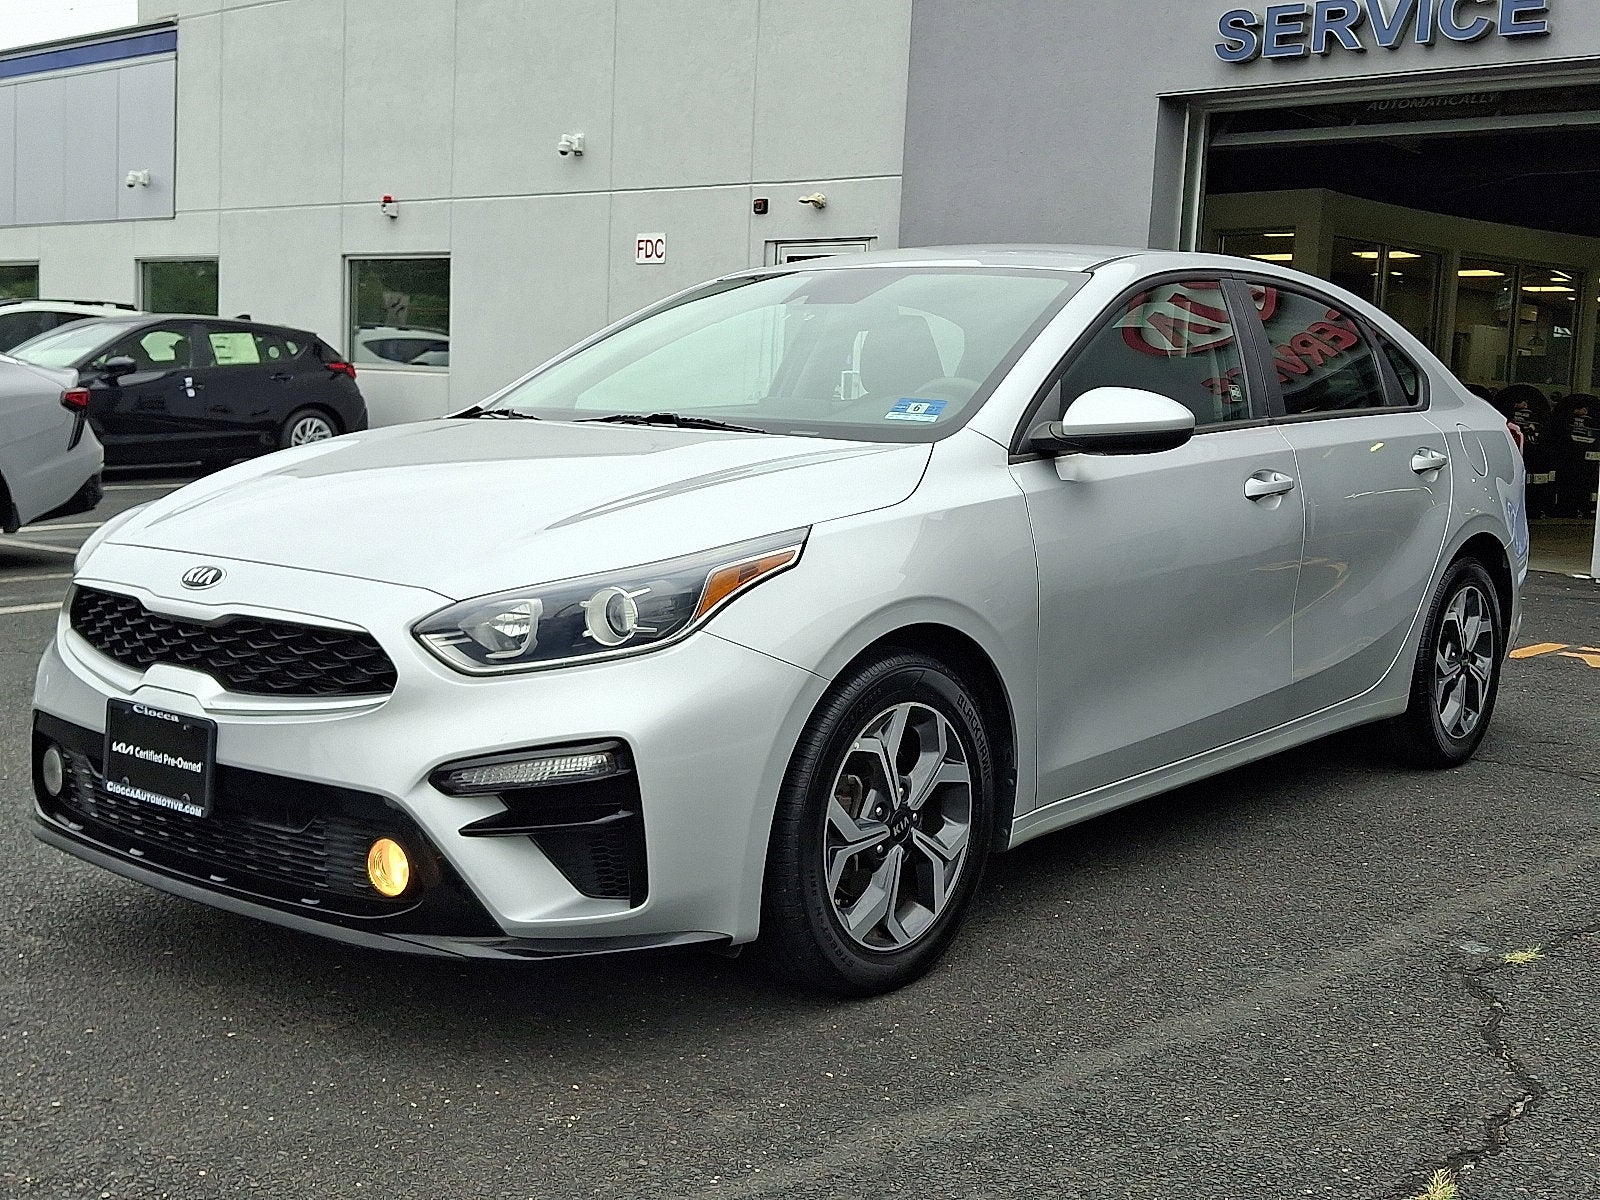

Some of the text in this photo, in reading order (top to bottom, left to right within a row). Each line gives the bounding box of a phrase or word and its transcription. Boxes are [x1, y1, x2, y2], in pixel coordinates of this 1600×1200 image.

[1214, 0, 1549, 63] SERVICE
[1366, 93, 1499, 111] AUTOMATICALLY
[636, 238, 664, 258] FDC
[913, 403, 922, 412] 6
[183, 566, 217, 585] KIA
[132, 704, 180, 723] Ciocca
[956, 693, 992, 783] BLACKHAWK
[111, 740, 202, 774] KIA Certified Pre-Owned
[892, 815, 910, 837] KIA
